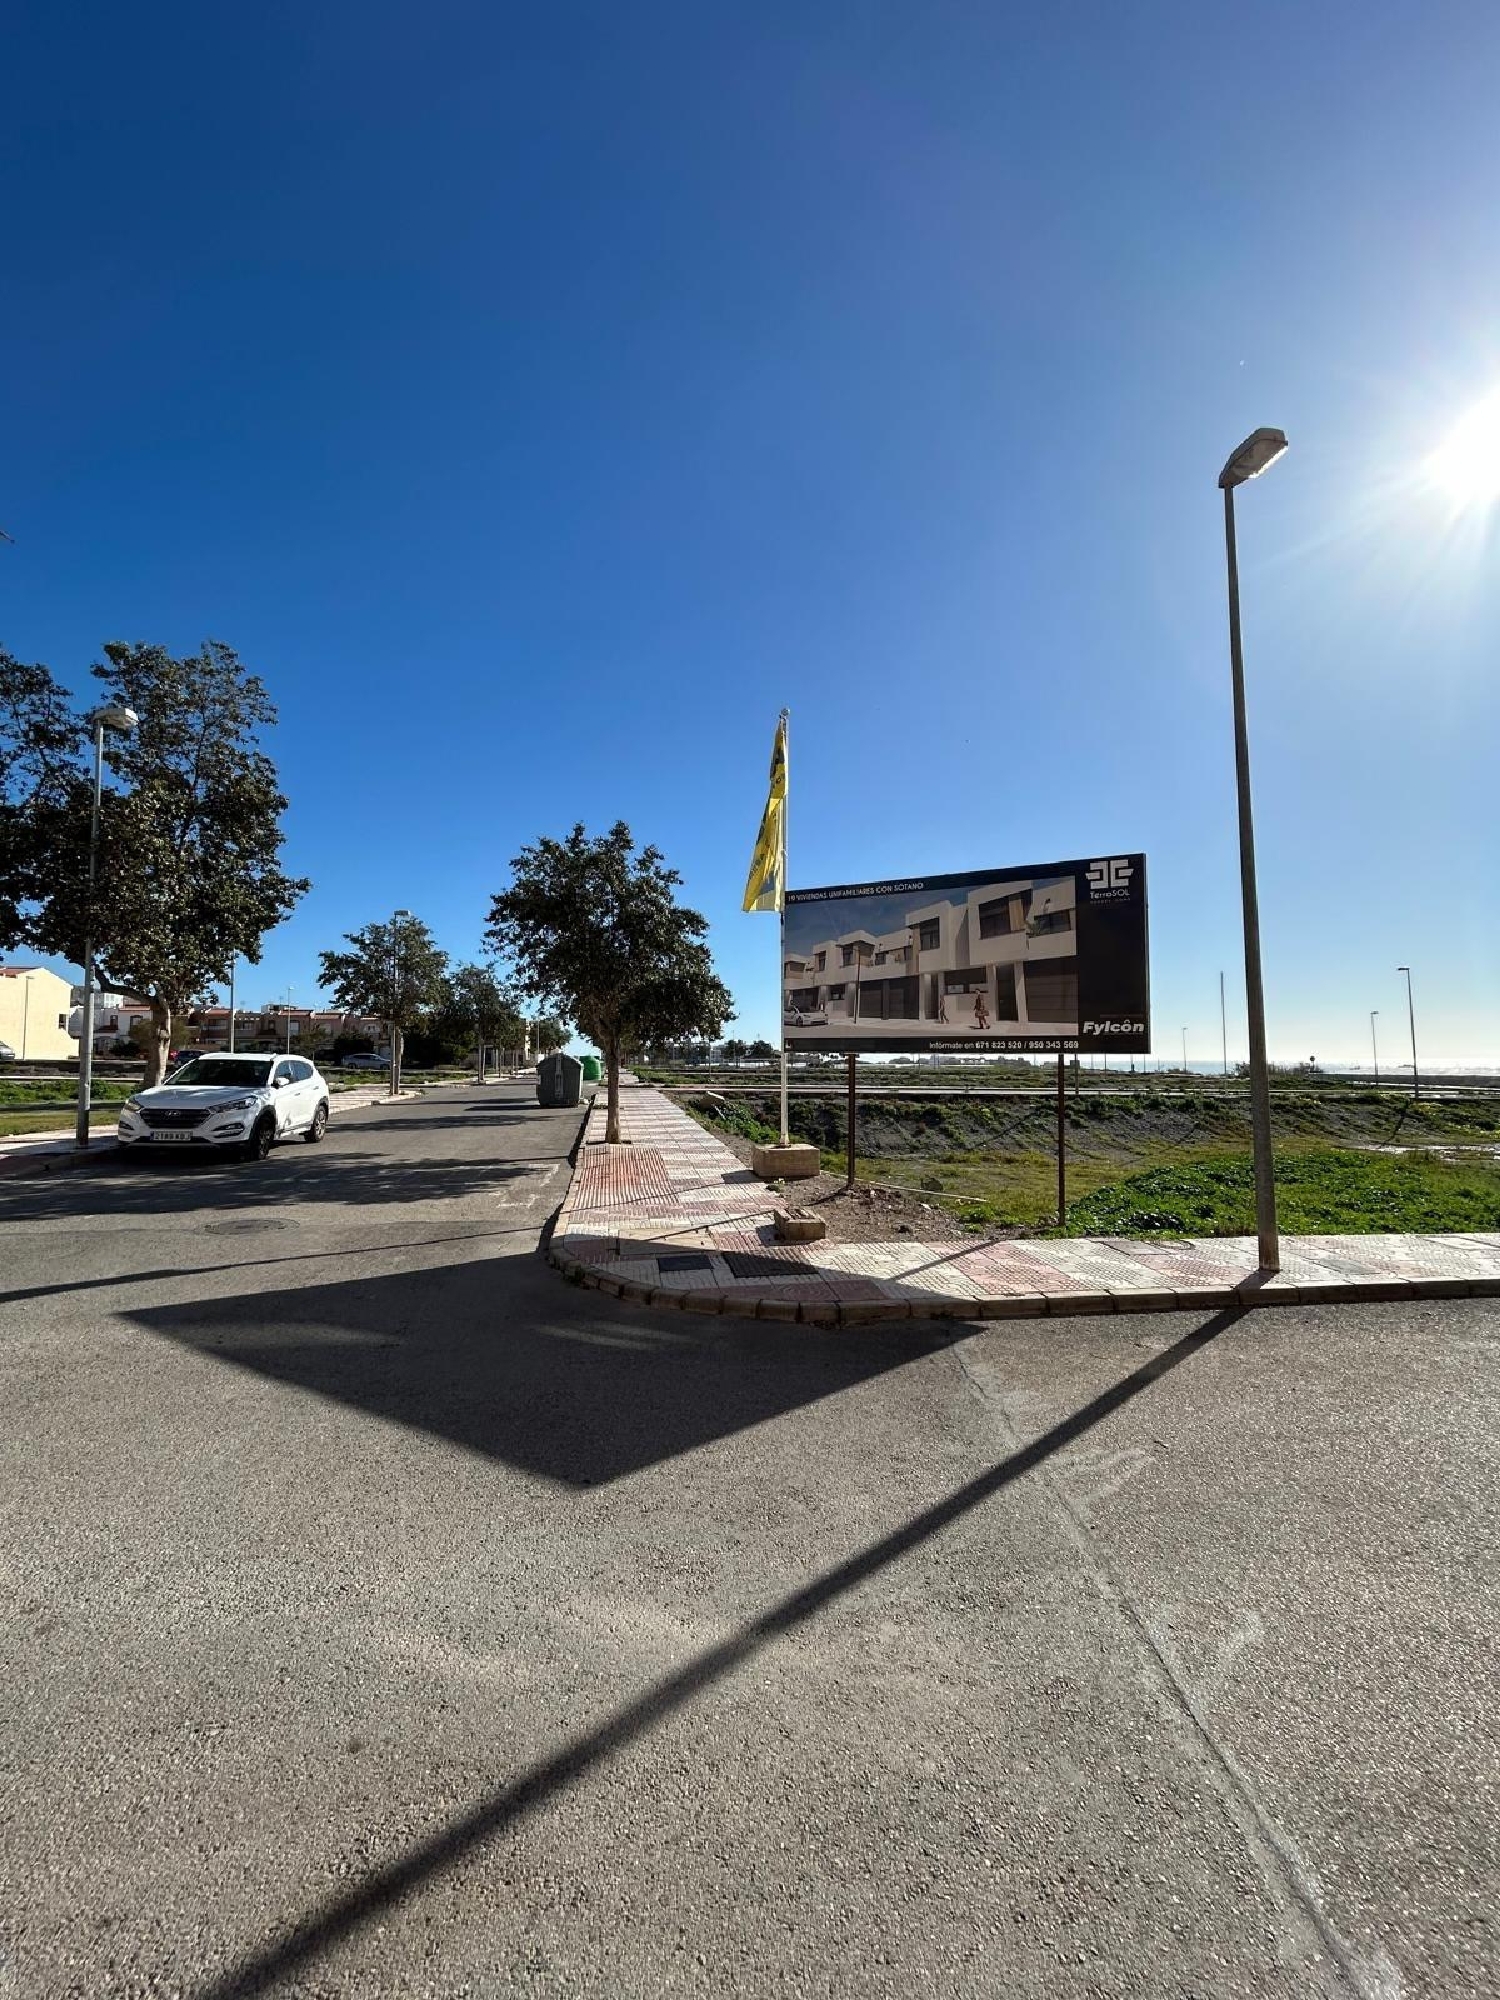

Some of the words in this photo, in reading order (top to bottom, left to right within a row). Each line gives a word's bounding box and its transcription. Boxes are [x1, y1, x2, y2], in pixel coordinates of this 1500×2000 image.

[796, 892, 827, 901] VIVIENDAS
[829, 887, 875, 899] UNIFAMILIARES
[876, 885, 892, 894] CON
[1090, 888, 1130, 899] TerraSOL
[1028, 1040, 1044, 1049] 950
[1045, 1040, 1061, 1049] 343
